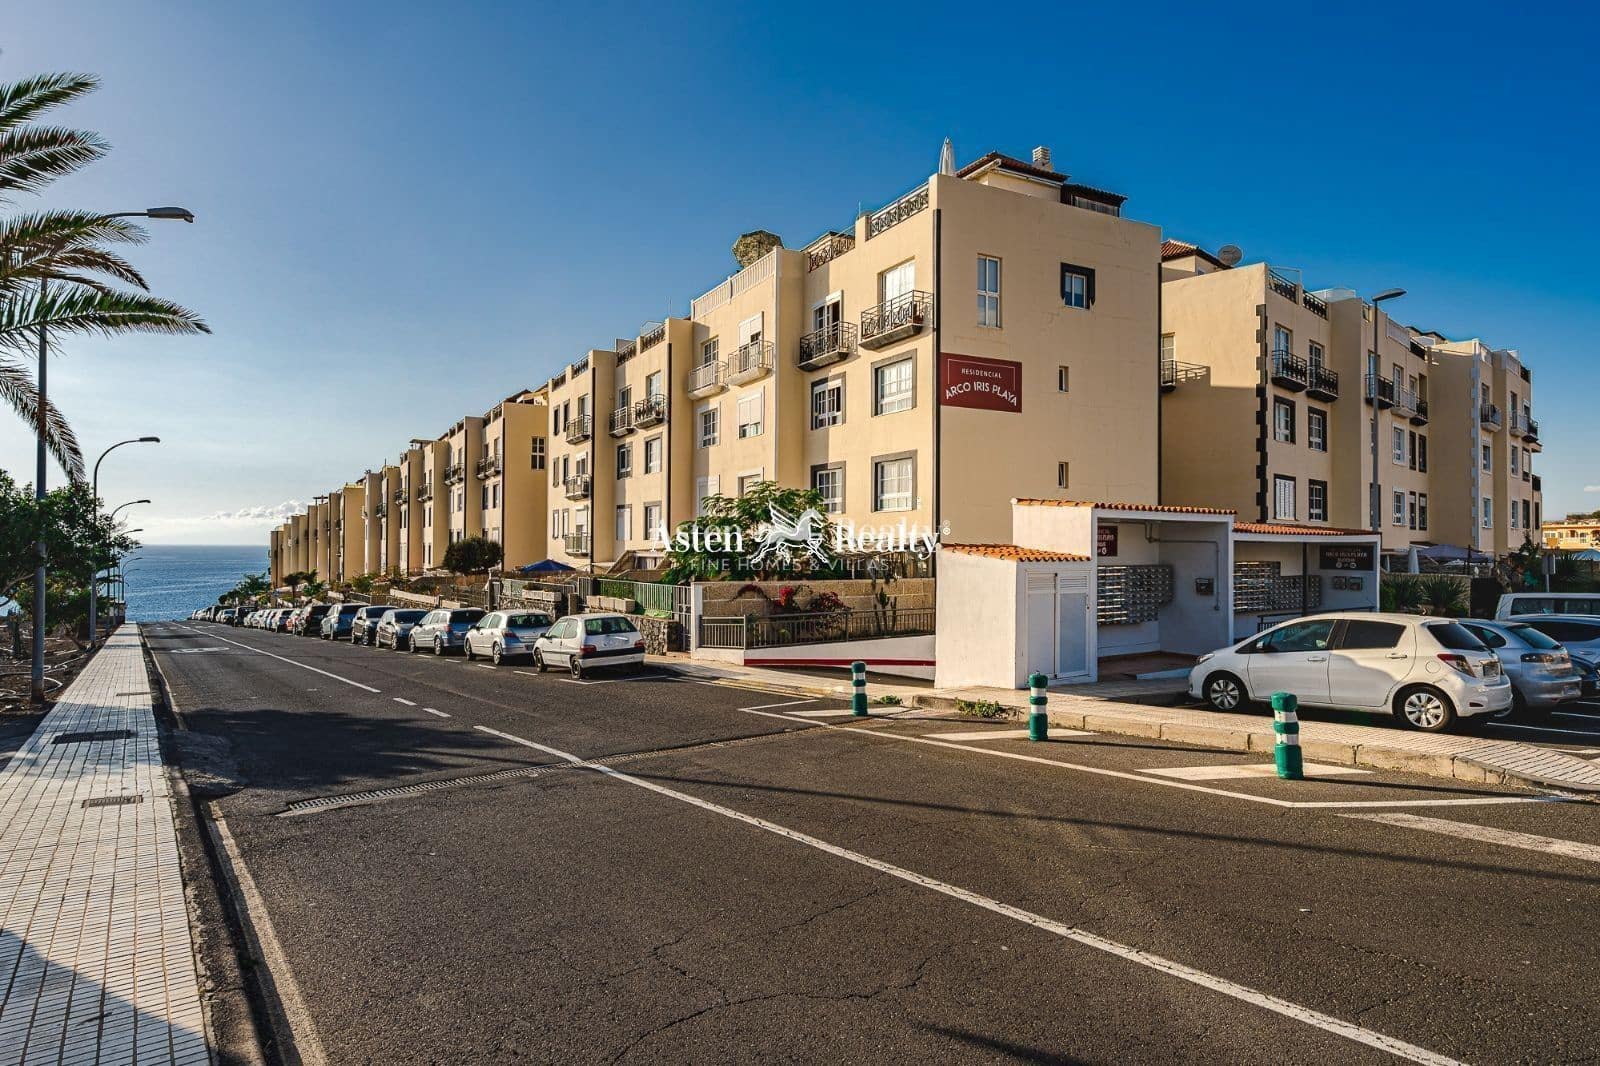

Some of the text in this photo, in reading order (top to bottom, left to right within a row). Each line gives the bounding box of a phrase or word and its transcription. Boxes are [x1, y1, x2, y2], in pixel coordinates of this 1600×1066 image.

[961, 368, 1002, 379] RESIDENCIAL
[945, 381, 1017, 406] ARCO IRIS PLAYA
